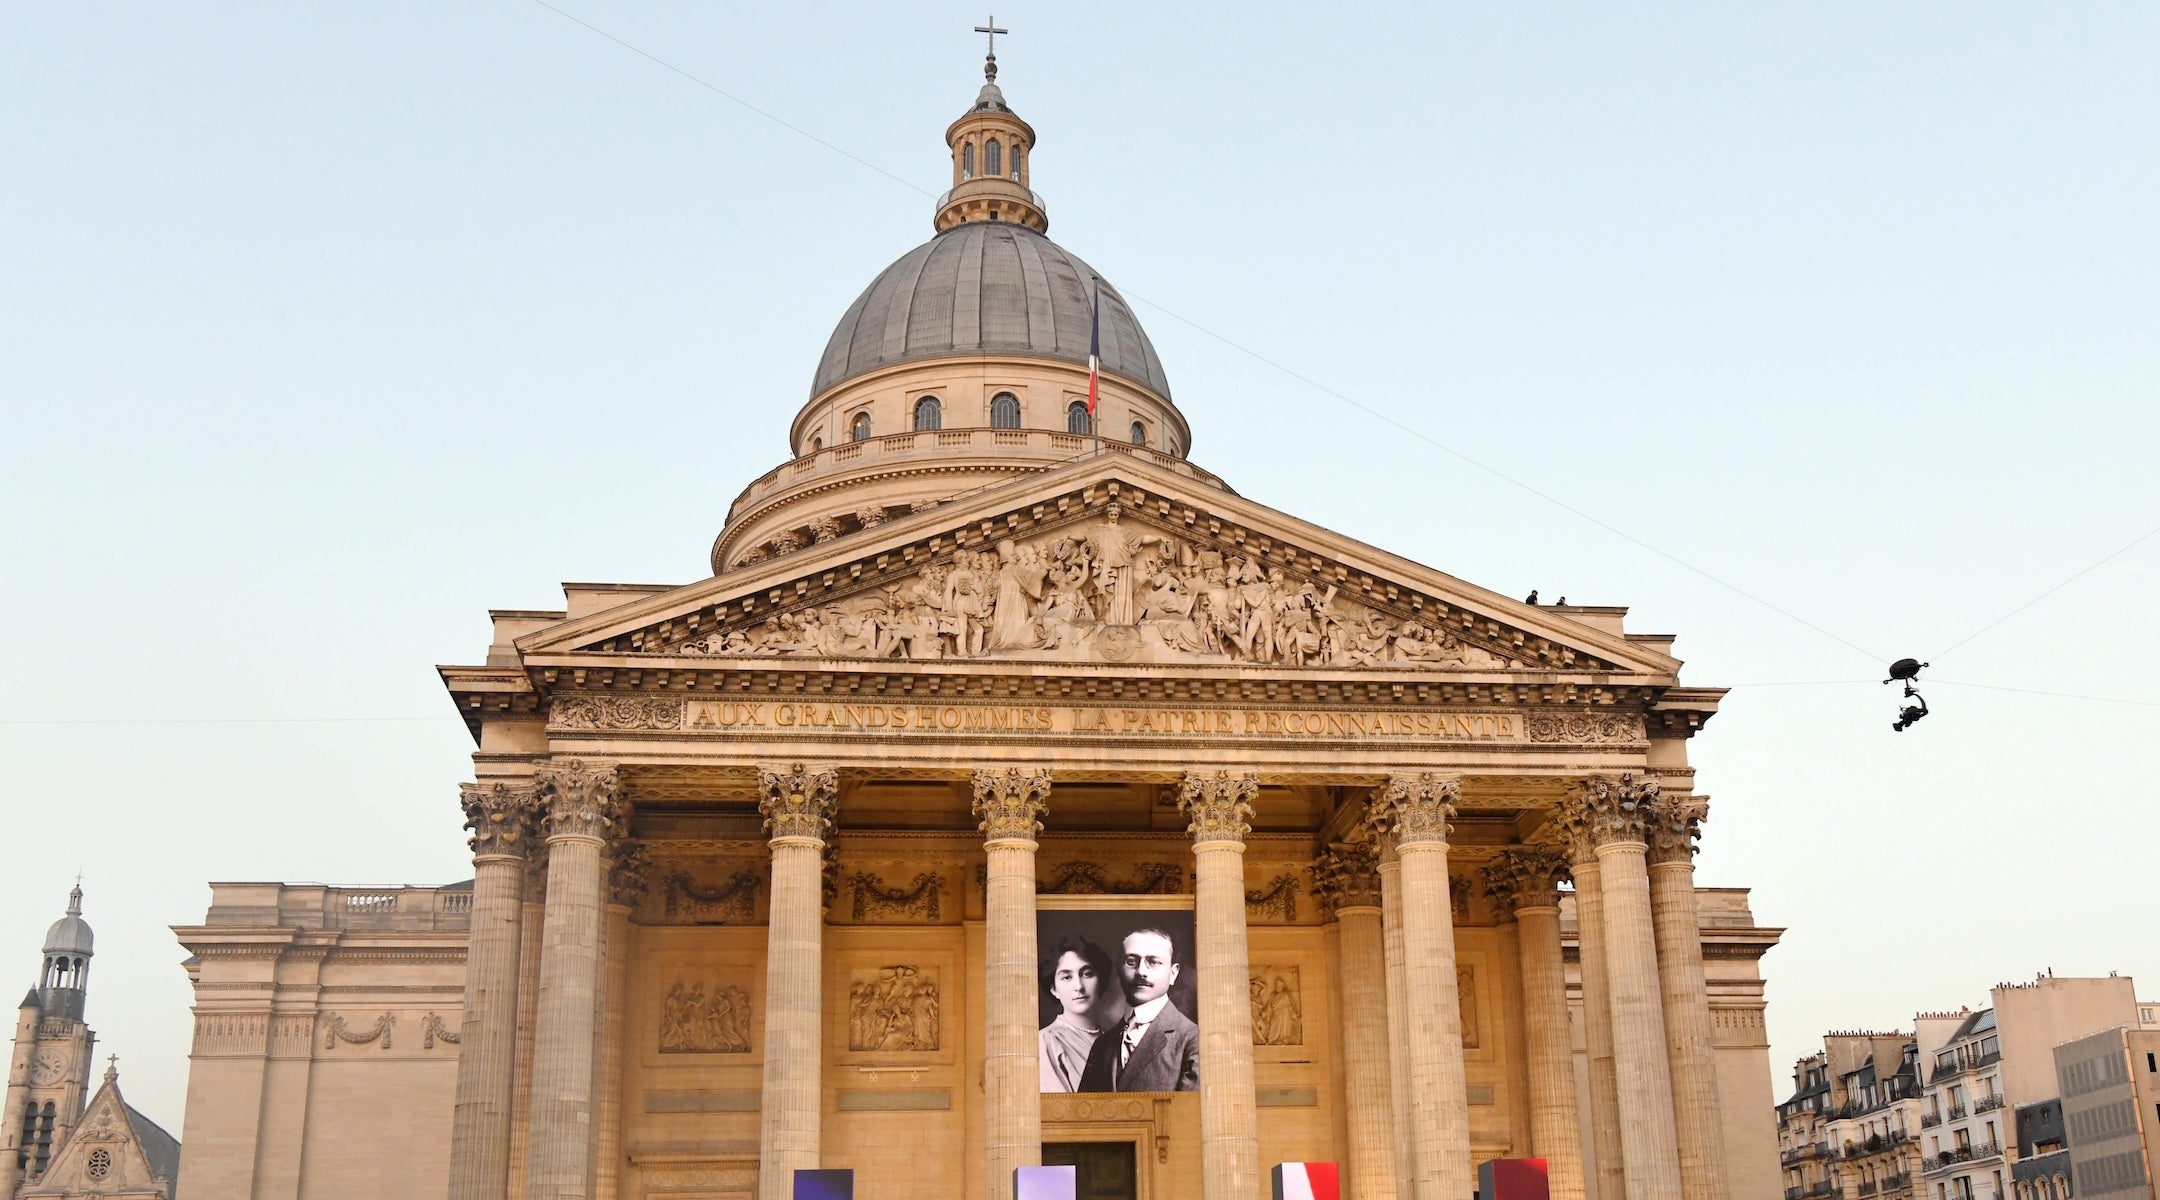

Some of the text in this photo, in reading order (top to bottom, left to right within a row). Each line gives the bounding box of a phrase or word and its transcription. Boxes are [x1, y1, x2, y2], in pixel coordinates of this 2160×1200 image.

[693, 703, 1514, 737] AUX GRANDS HOMMES LA PATRIE RECONNAISSANTE
